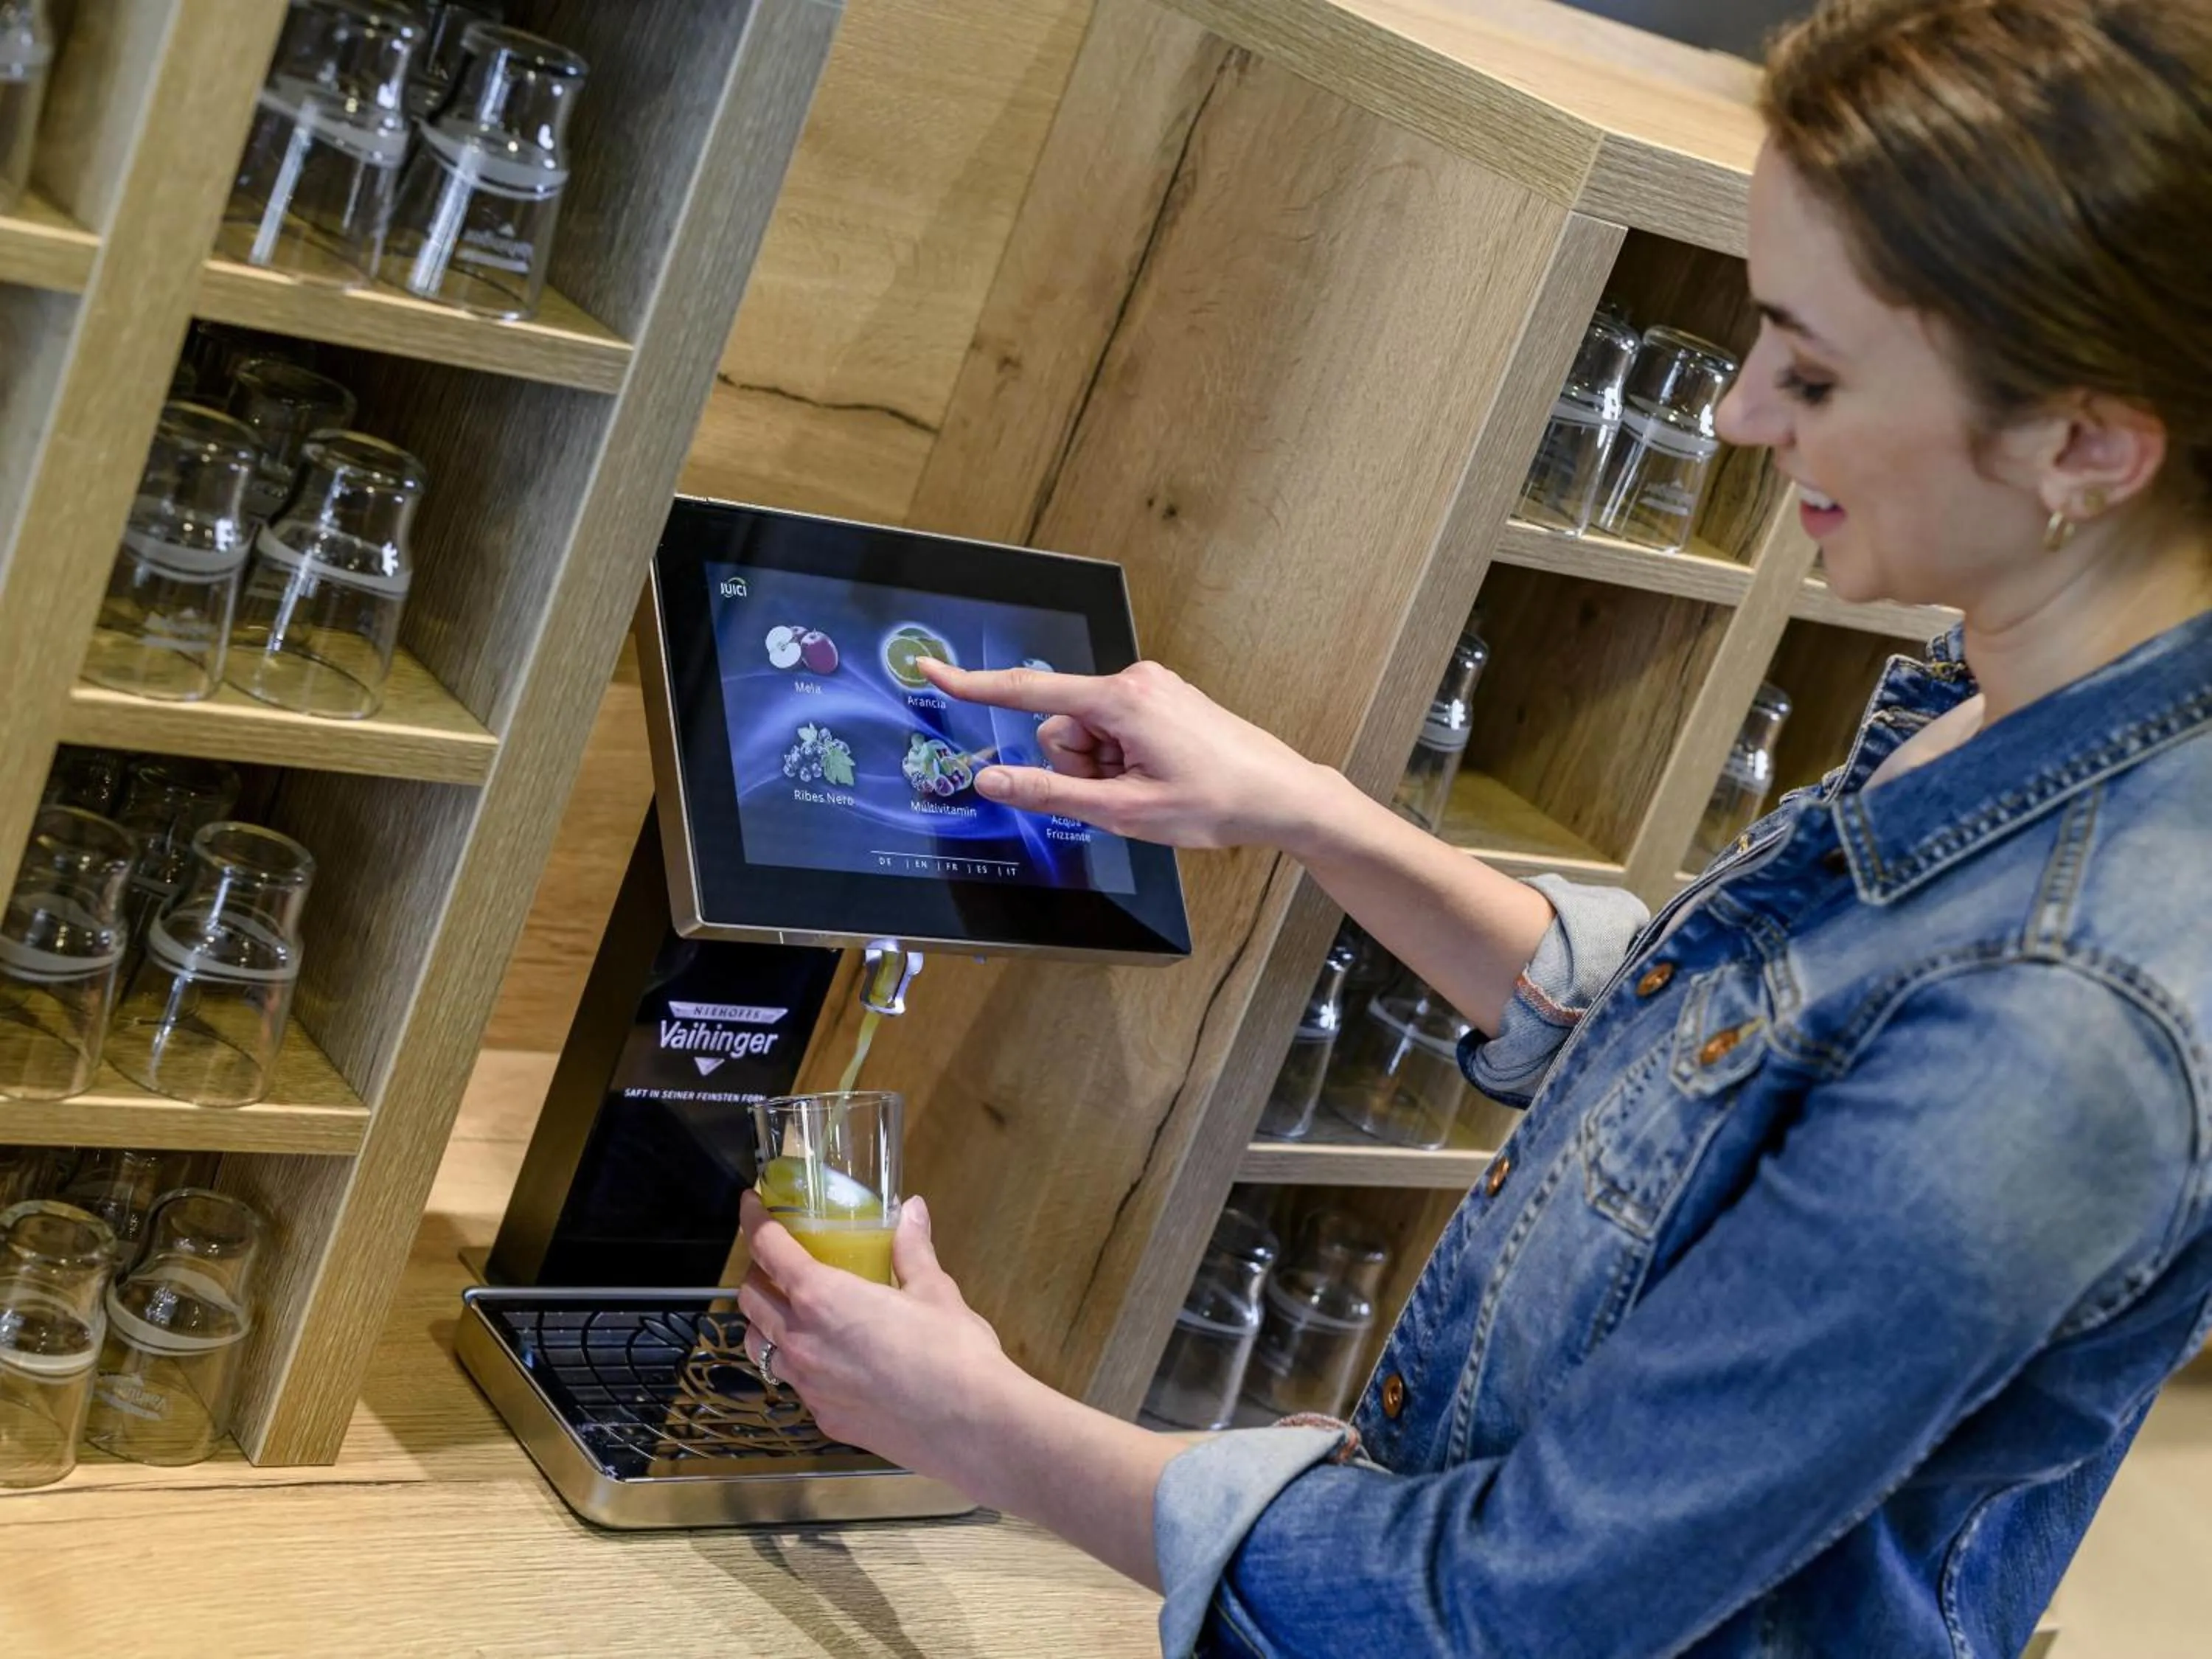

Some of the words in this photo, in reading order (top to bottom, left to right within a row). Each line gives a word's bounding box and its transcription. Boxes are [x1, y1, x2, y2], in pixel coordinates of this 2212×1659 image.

[794, 681, 822, 695] Mela
[908, 695, 947, 709] Arancia
[794, 790, 824, 803] Ribes
[827, 793, 855, 806] Nero
[911, 801, 978, 817] Multivitamin
[1051, 815, 1082, 829] Acqua
[1046, 828, 1091, 843] Frizzante
[879, 857, 891, 866] DE
[915, 860, 928, 869] EN
[946, 862, 959, 871] FR
[976, 865, 988, 874] ES
[1006, 866, 1018, 876] IT
[693, 1006, 761, 1020] NIEHOFFS
[660, 1019, 779, 1059] Vaihinger
[624, 1088, 647, 1098] SAFT
[649, 1089, 661, 1099] IN
[661, 1089, 695, 1100] SEINER
[696, 1091, 740, 1102] FEINSTEN
